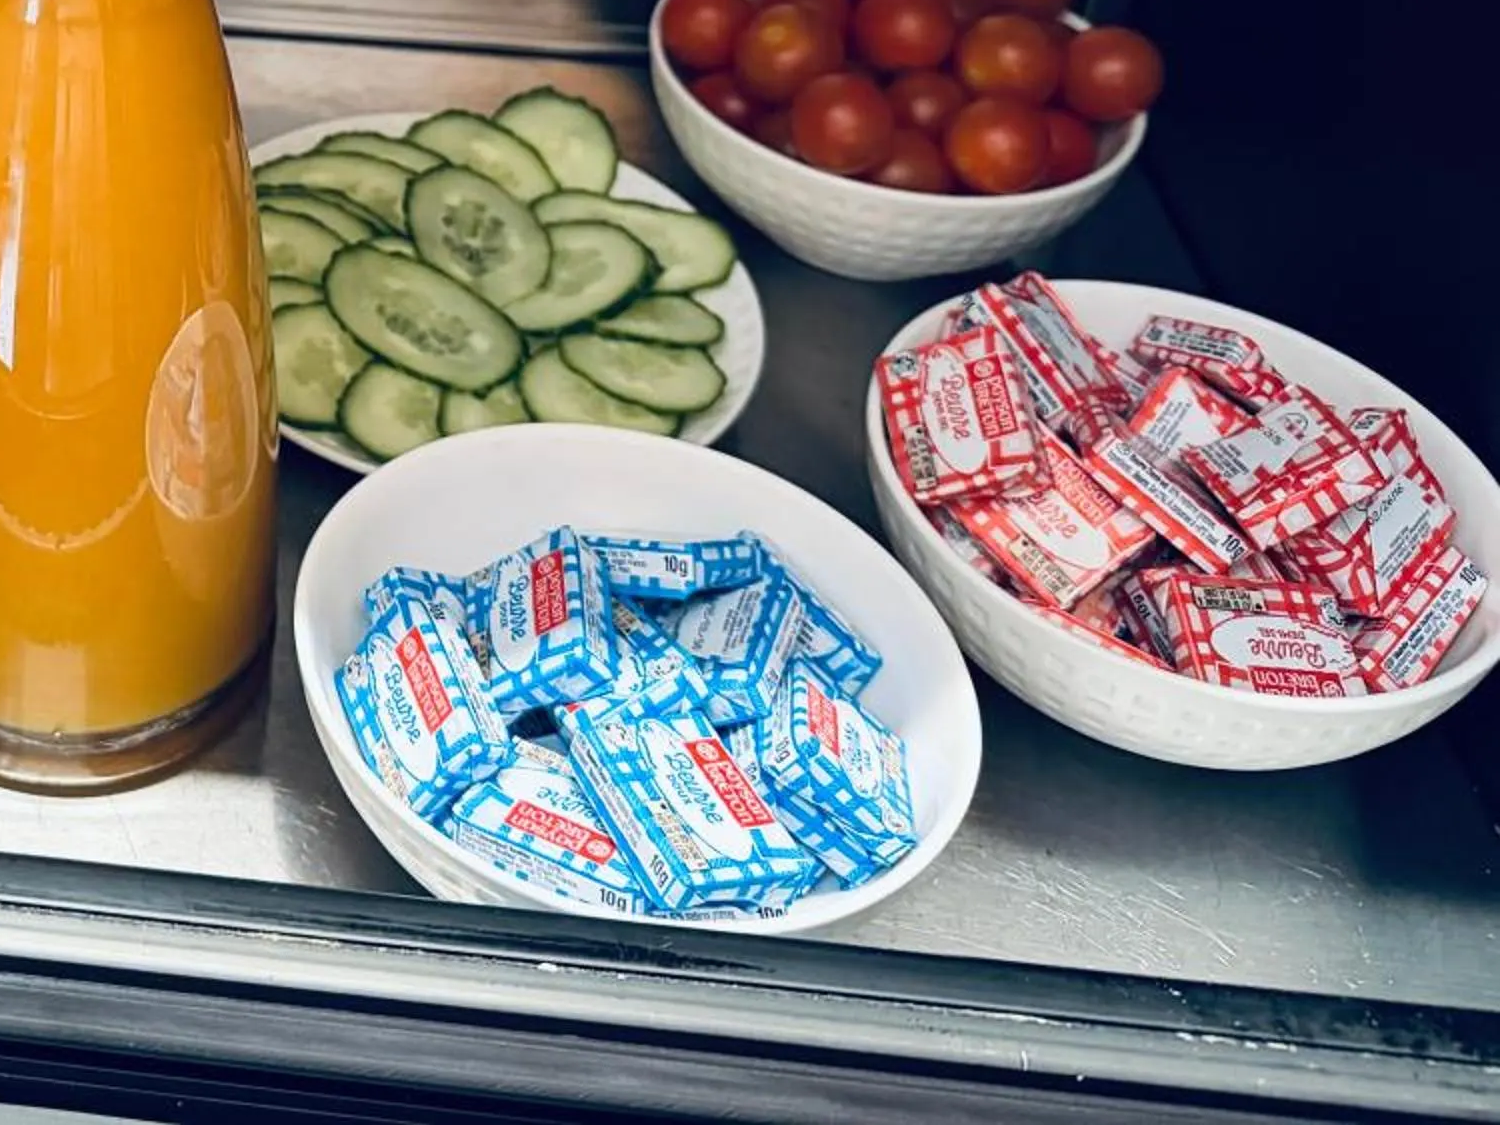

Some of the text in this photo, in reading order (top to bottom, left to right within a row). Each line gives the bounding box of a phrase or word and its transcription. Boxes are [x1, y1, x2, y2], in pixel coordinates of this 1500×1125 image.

[1221, 534, 1245, 560] 10g
[663, 554, 688, 577] 10g
[1248, 638, 1327, 669] Beurre
[385, 663, 421, 744] Beurre
[665, 752, 723, 823] Beurre
[650, 854, 669, 889] 10g
[600, 888, 627, 912] 10g
